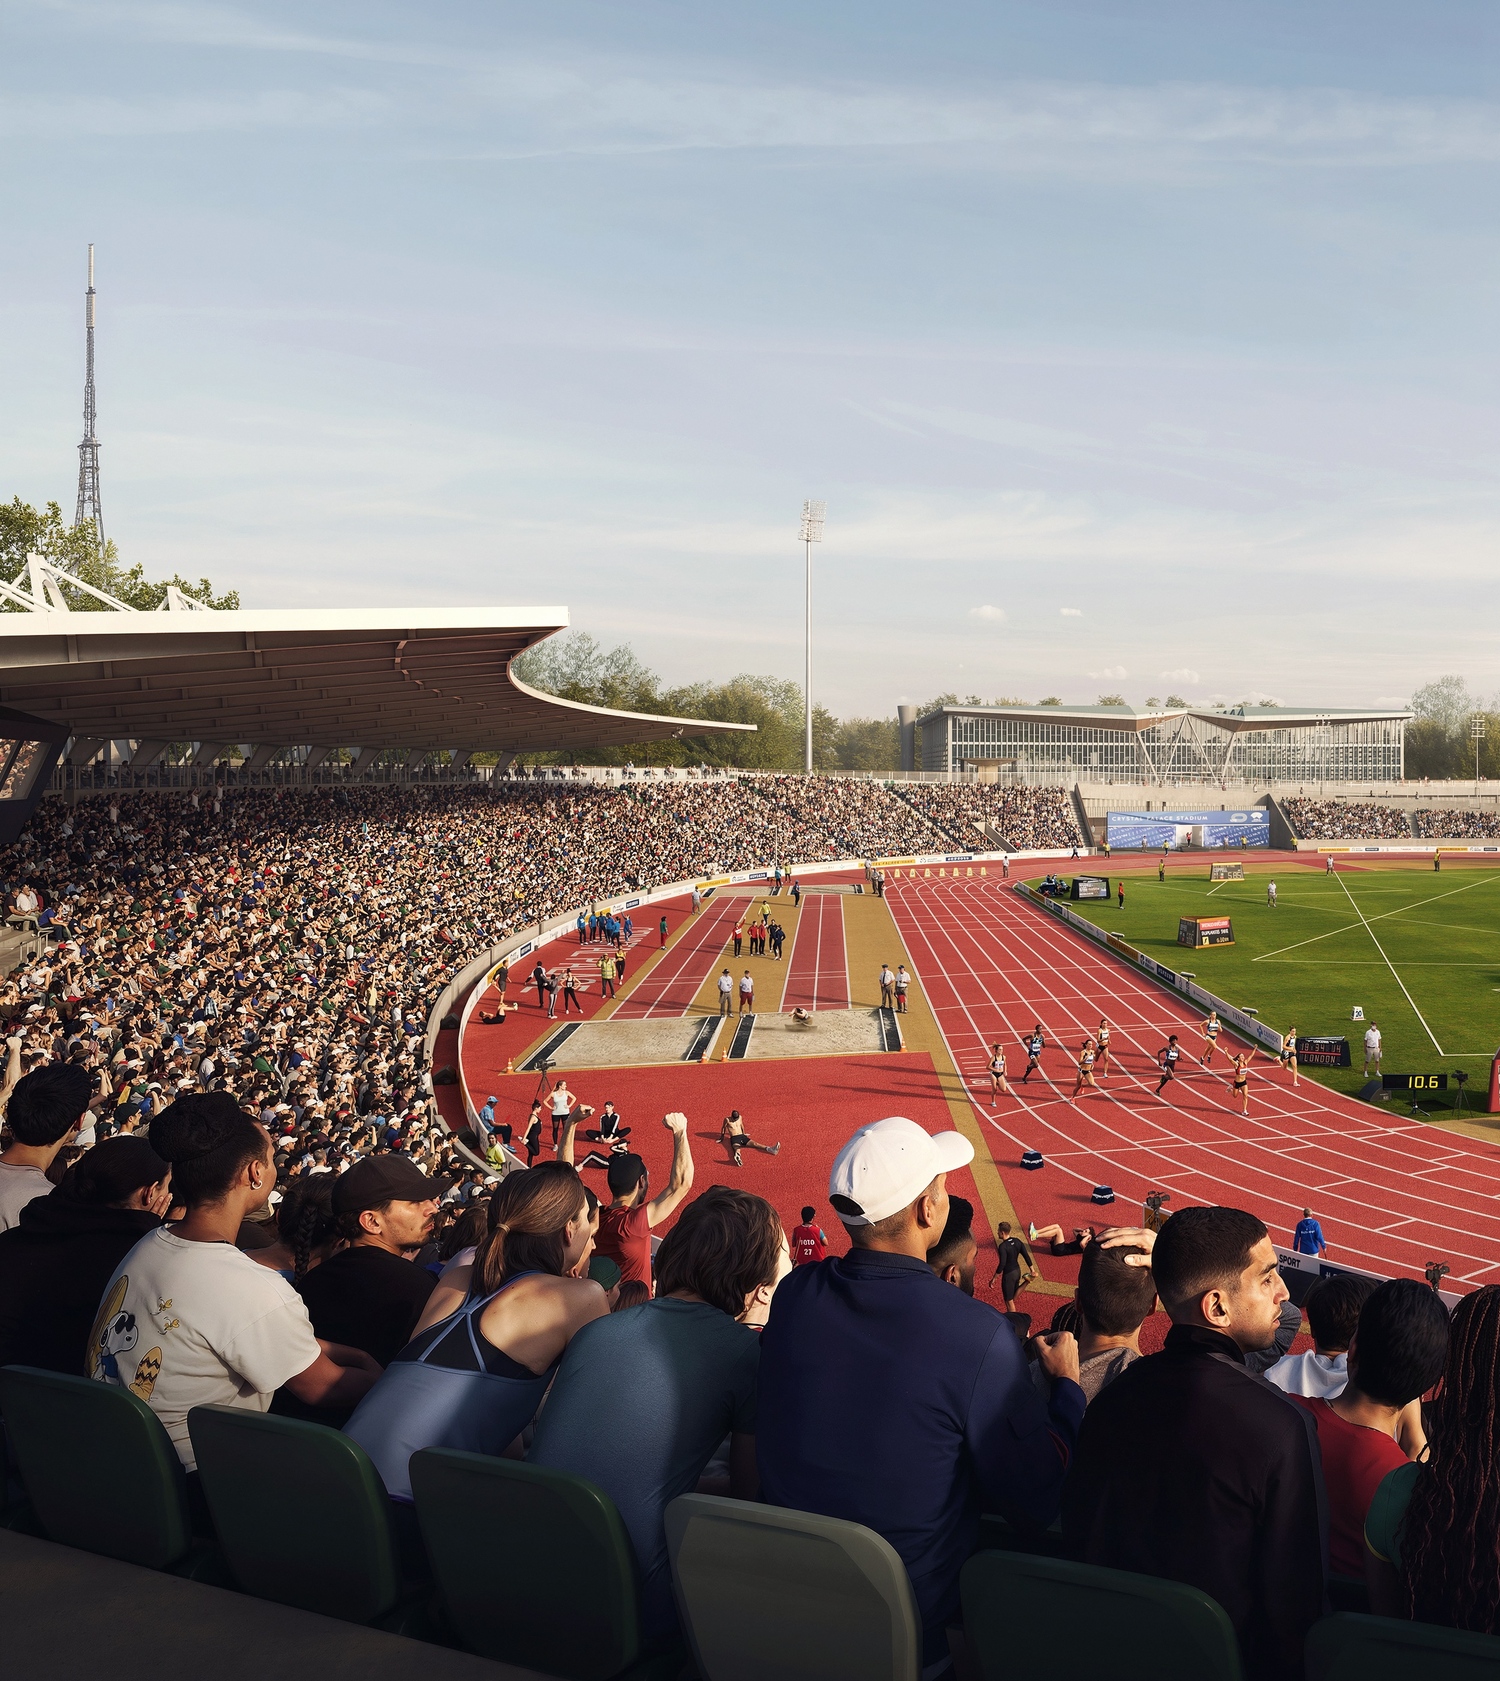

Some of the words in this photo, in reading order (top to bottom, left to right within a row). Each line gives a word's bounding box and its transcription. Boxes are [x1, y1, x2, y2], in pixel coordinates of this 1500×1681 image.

[1303, 1053, 1336, 1064] LONDON
[1408, 1076, 1439, 1089] 10.6
[1279, 1254, 1300, 1268] SPORT
